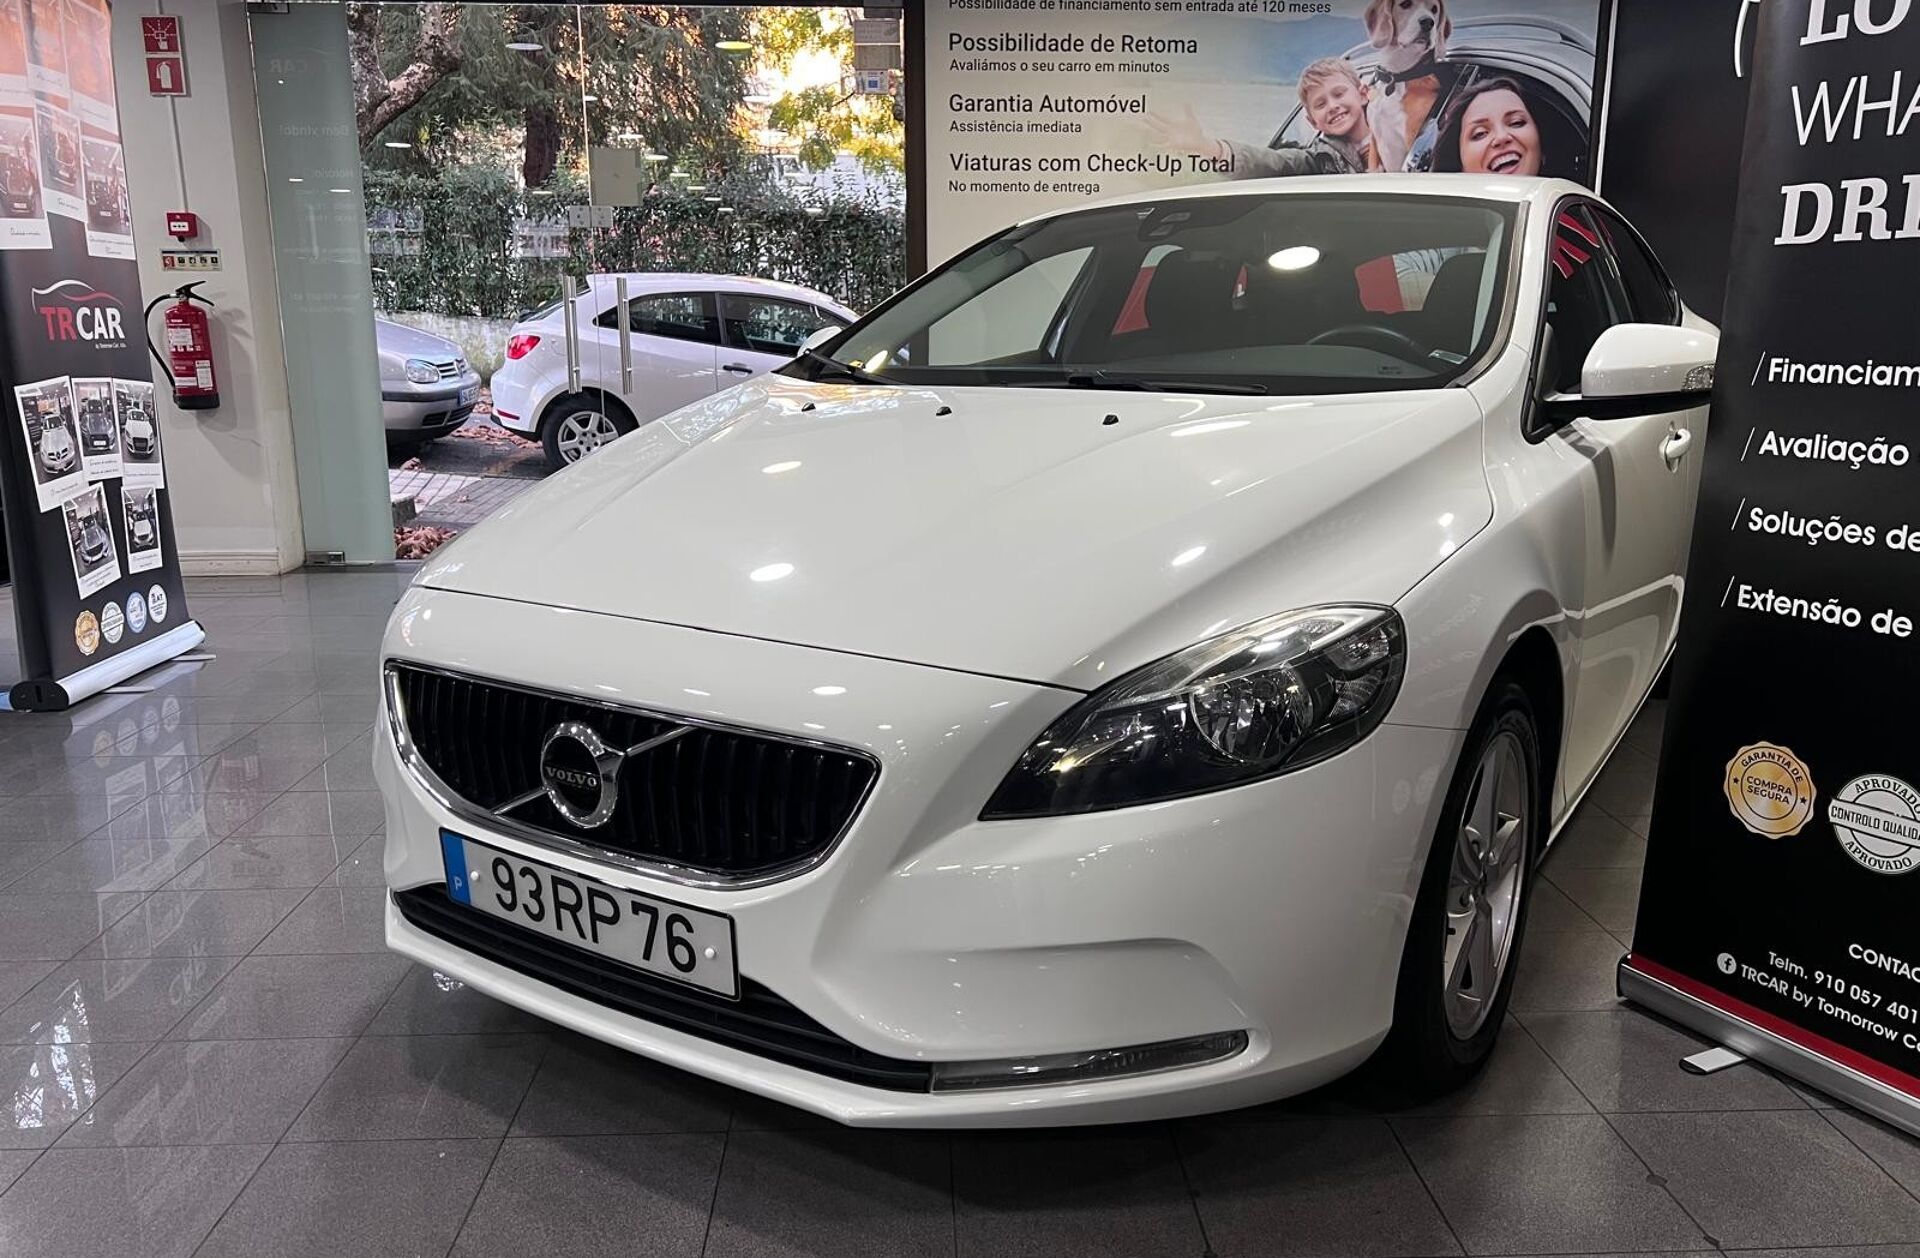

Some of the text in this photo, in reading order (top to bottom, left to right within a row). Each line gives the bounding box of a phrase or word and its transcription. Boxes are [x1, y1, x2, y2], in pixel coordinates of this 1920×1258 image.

[1155, 2, 1182, 12] sem
[1186, 0, 1234, 12] entrada
[1238, 0, 1259, 13] até
[1263, 1, 1285, 13] 120
[1289, 3, 1332, 14] meses
[949, 33, 1198, 54] Possibilidade de Retoma
[950, 59, 1171, 74] Avaliámos o seu carro em minutos
[949, 94, 1147, 113] Garantia Automóvel
[950, 121, 1082, 133] Assistência imediata
[950, 153, 1236, 176] Viaturas com Check-Up Total
[949, 181, 1100, 195] No momento de entrega
[39, 306, 126, 341] TRCAR
[1758, 430, 1910, 470] Avaliação
[1748, 506, 1877, 546] Soluções
[1737, 583, 1913, 638] Extensão de
[546, 765, 598, 789] VOLVO
[1740, 751, 1804, 784] GARANTIA DE
[1746, 775, 1793, 796] COMPRA
[1746, 784, 1791, 806] SEGURA
[1854, 778, 1920, 815] APROVADO
[1830, 805, 1920, 841] CONTROLO QUALID
[1844, 839, 1912, 871] APROVADO
[1768, 951, 1918, 1025] Telm. 910 057 401
[1740, 964, 1789, 997] TRCAR
[1792, 986, 1814, 1008] by
[1817, 996, 1899, 1042] Tomorrow
